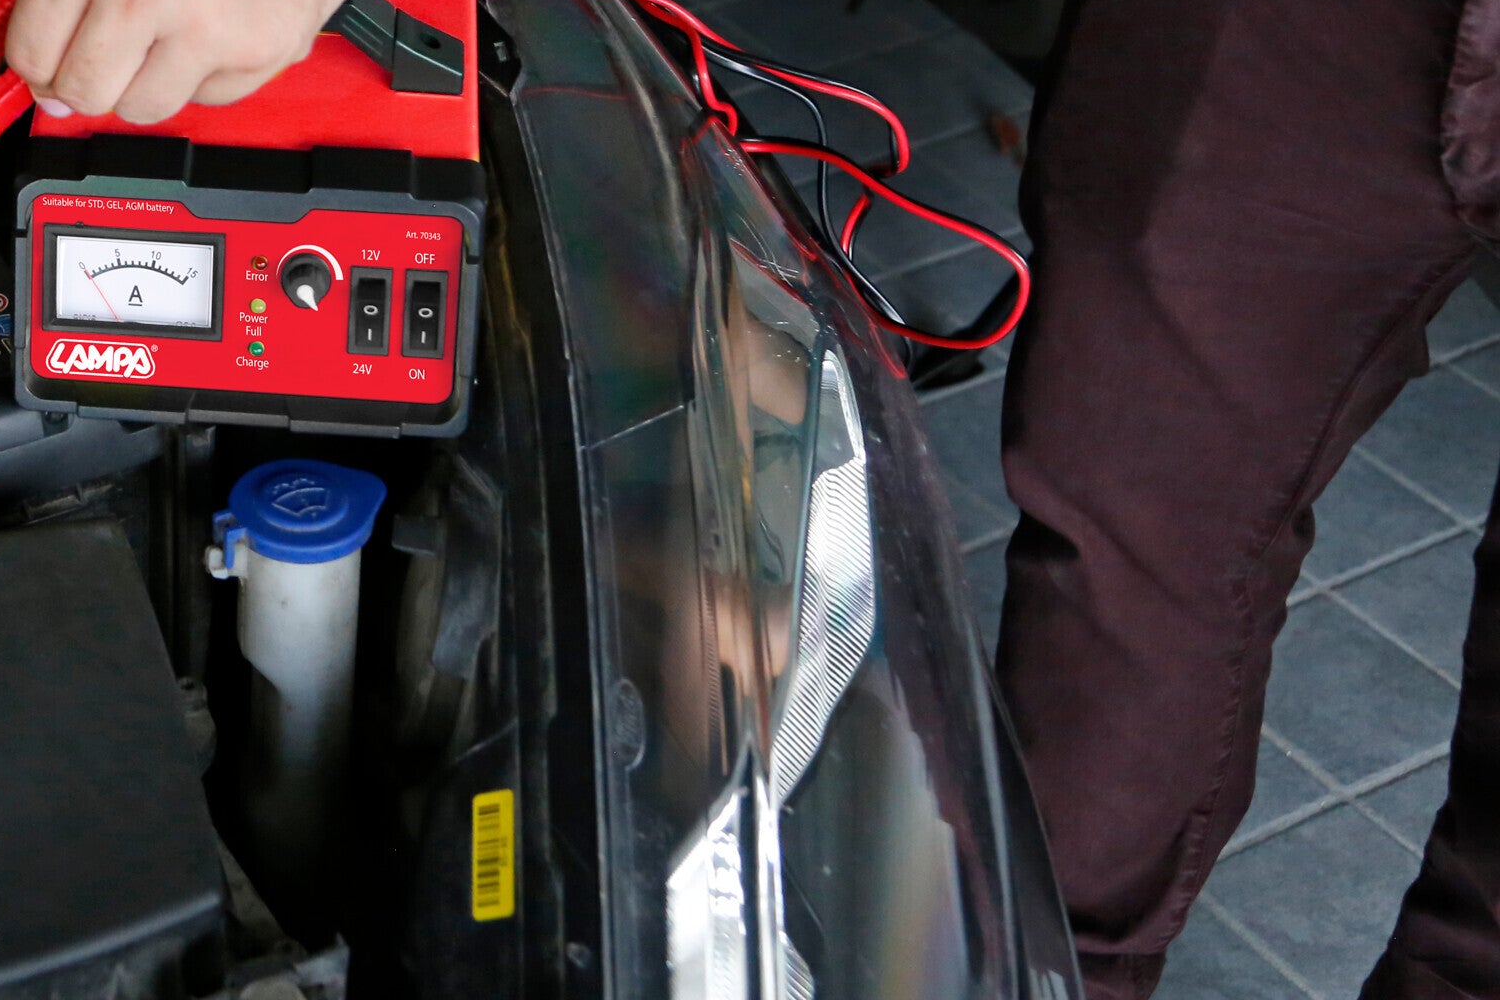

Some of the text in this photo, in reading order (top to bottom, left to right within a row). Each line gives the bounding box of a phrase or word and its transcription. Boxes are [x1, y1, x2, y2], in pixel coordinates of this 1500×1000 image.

[42, 197, 175, 214] Suitable for STD, GEL, AGM battery
[406, 231, 442, 241] Art. 70343
[114, 249, 121, 258] 5
[151, 251, 162, 260] 10
[361, 250, 381, 261] 12V
[414, 253, 436, 264] OFF
[78, 261, 86, 270] 0
[186, 267, 199, 279] 15
[245, 271, 269, 282] Error
[129, 285, 143, 303] A
[239, 312, 268, 324] Power
[245, 326, 262, 336] Full
[50, 342, 151, 378] LAMPA
[235, 356, 269, 370] Charge
[352, 363, 373, 375] 24V
[408, 368, 426, 380] ON
